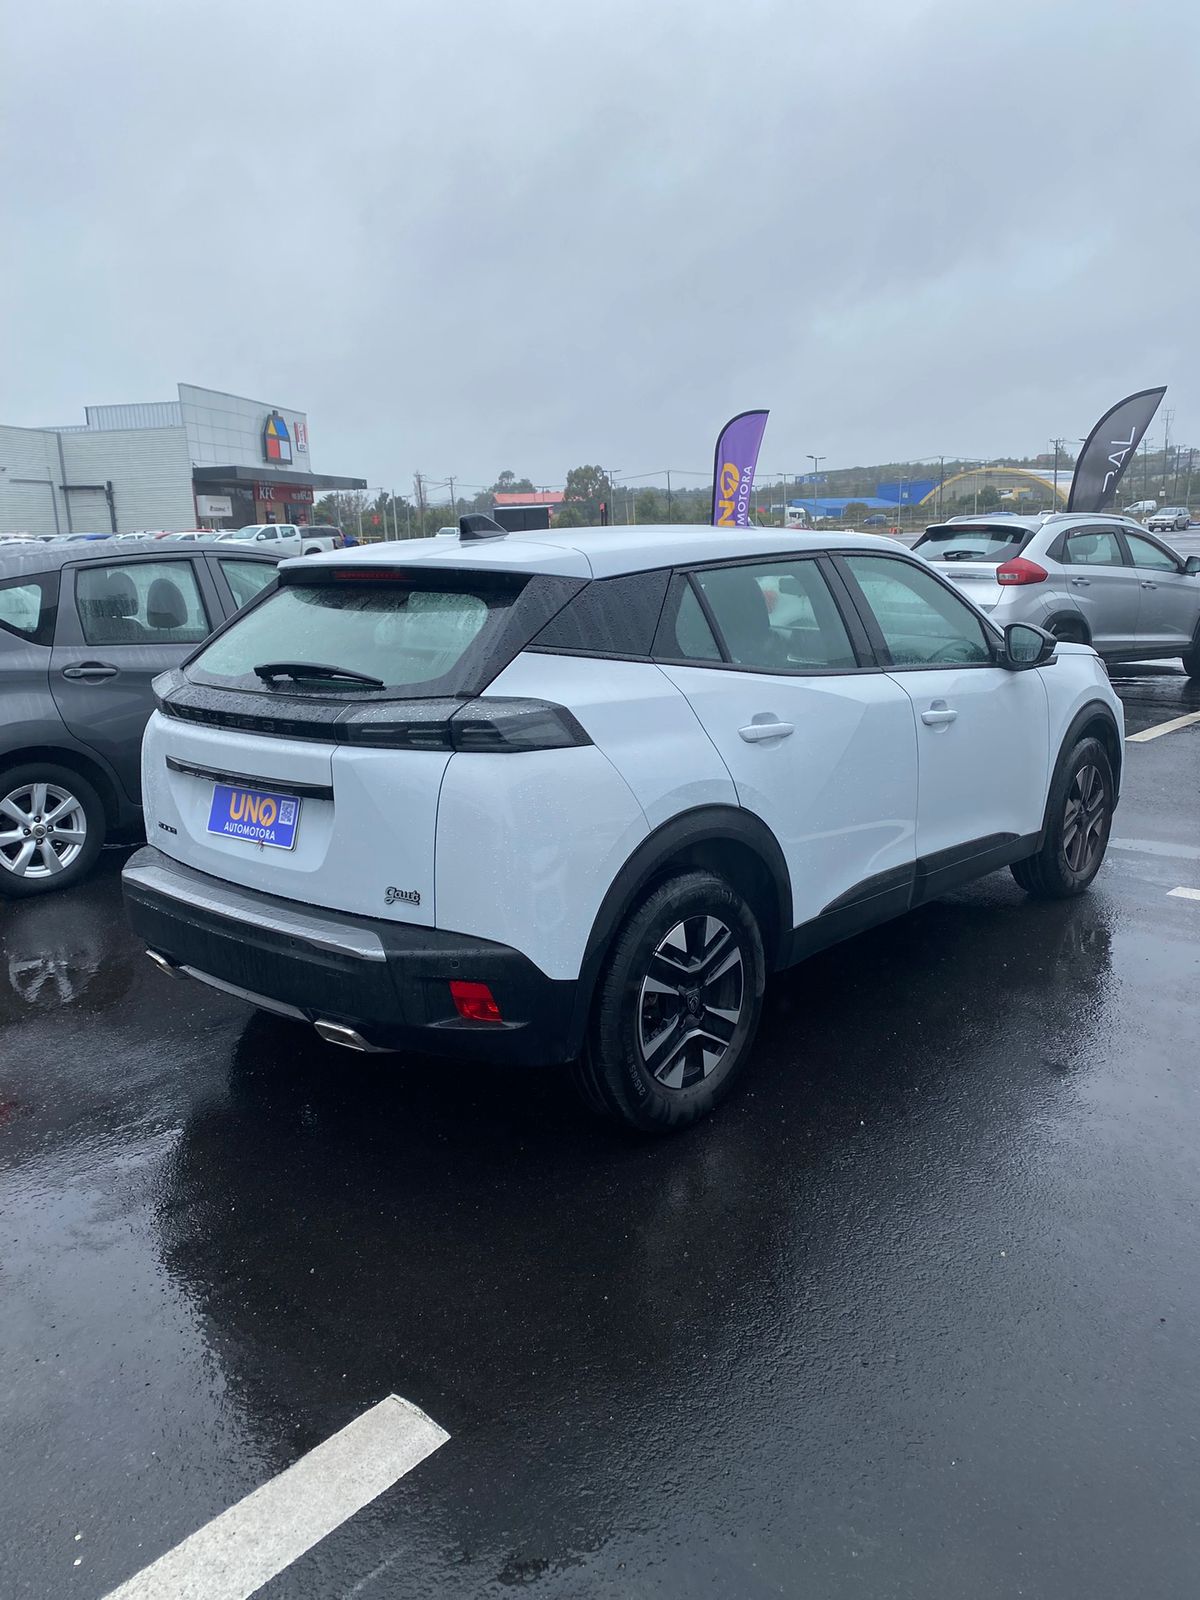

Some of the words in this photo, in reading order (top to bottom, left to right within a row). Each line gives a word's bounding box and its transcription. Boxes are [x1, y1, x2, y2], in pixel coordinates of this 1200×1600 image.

[259, 487, 274, 500] KFC
[737, 466, 752, 525] MOTORA
[229, 792, 277, 827] UNO
[223, 821, 276, 841] AUTOMOTORA
